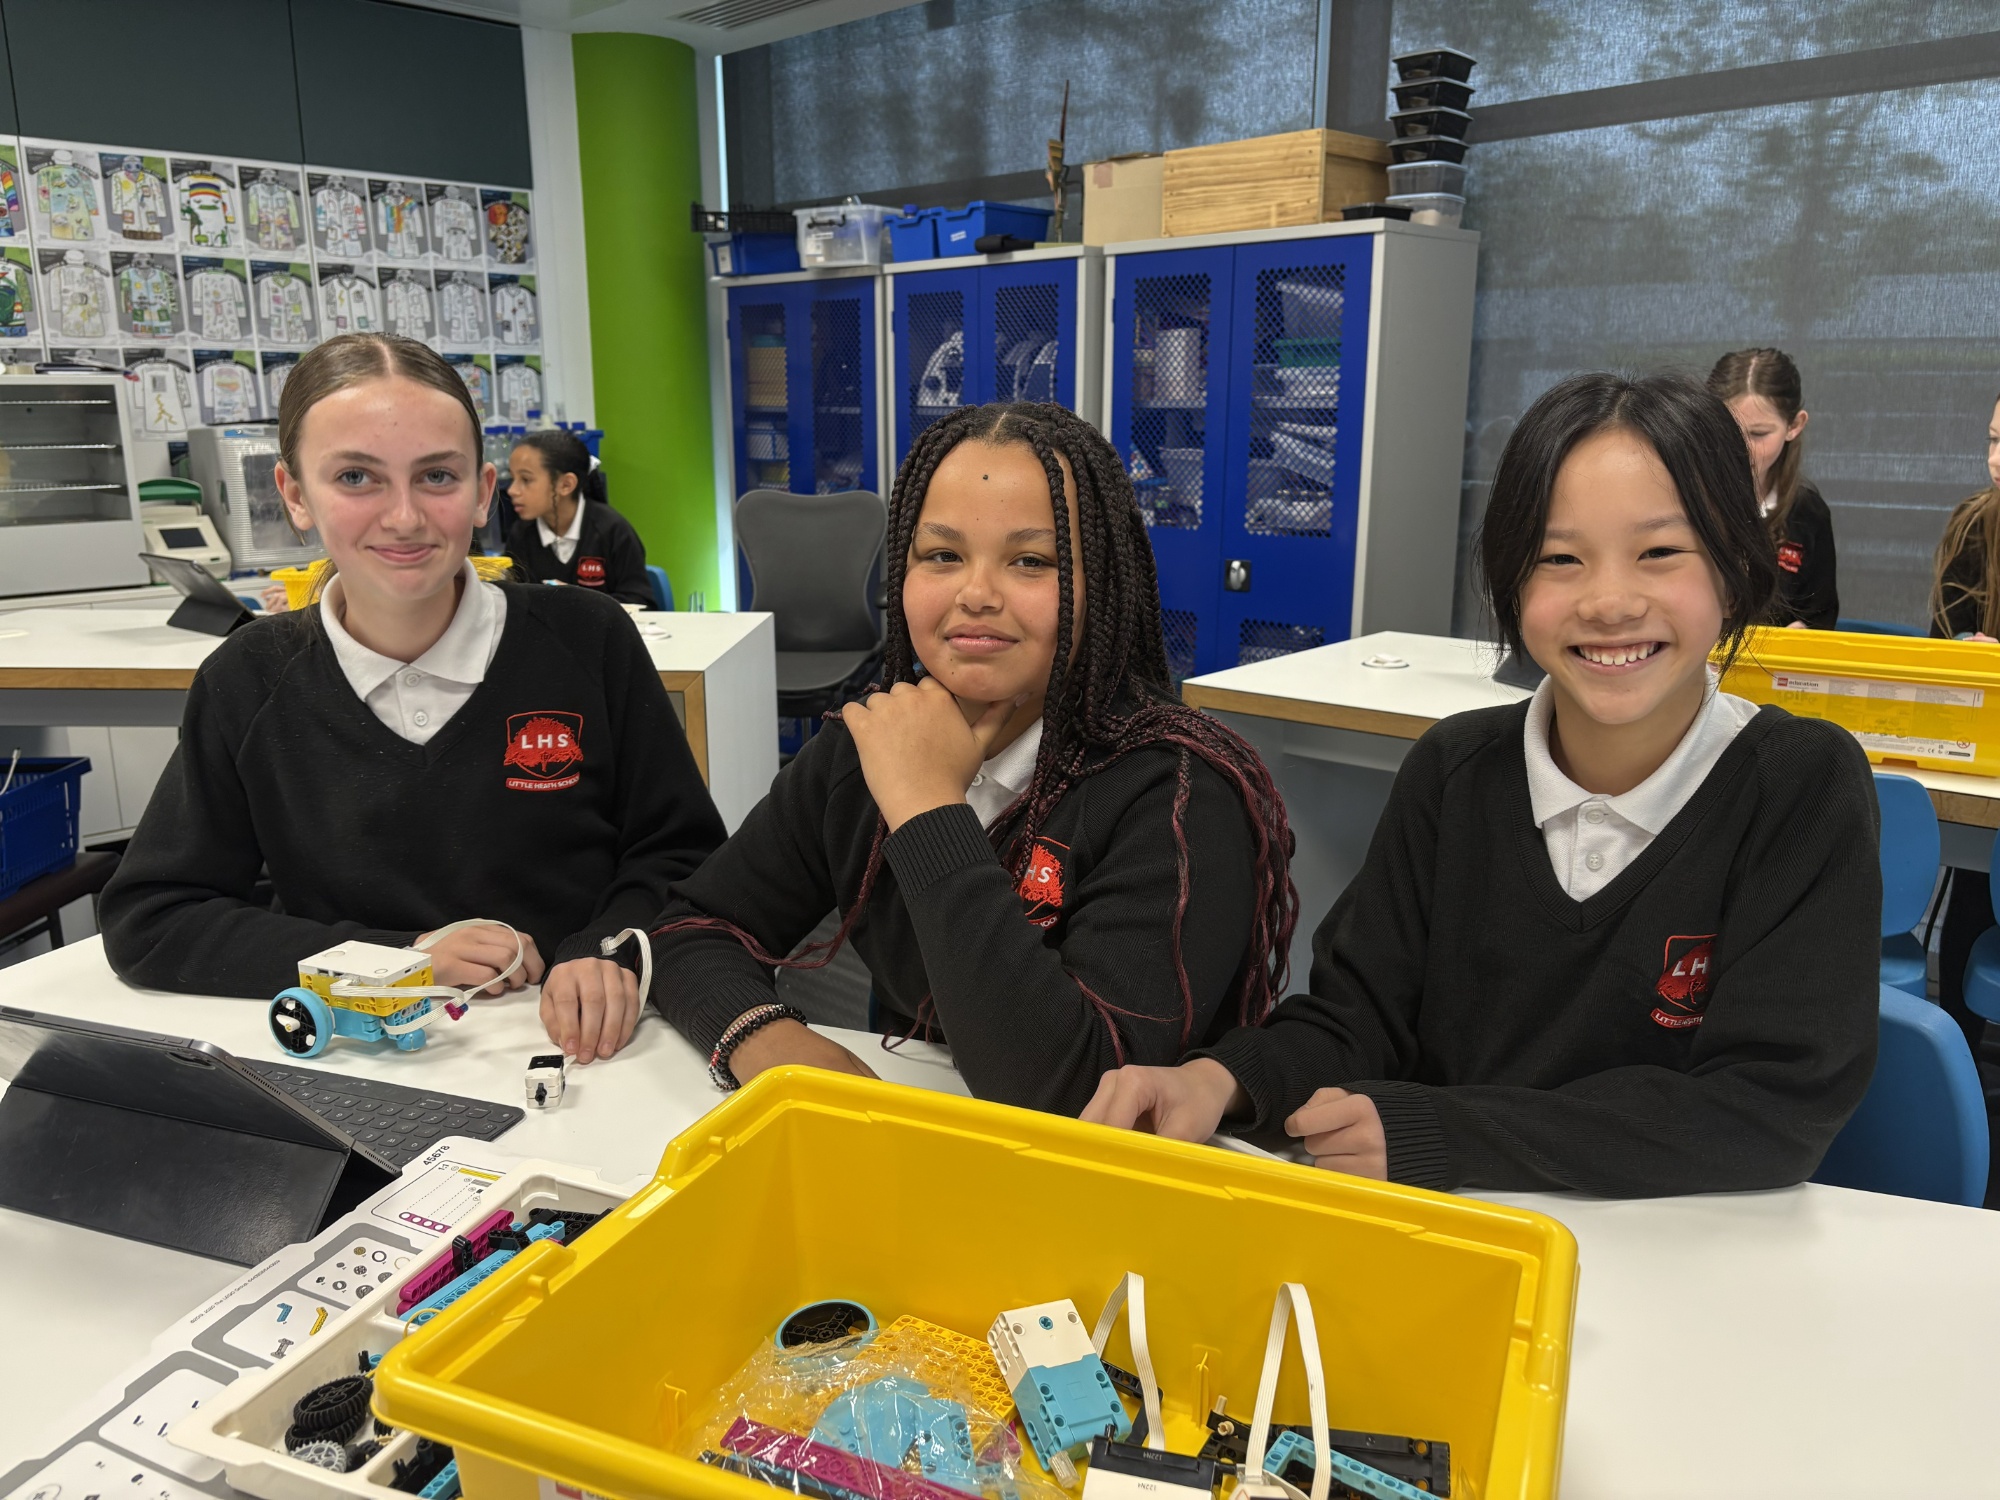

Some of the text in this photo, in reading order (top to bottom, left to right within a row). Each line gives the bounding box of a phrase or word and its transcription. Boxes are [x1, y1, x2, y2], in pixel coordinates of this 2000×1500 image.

[582, 564, 601, 572] LHS
[521, 733, 569, 749] LHS
[508, 780, 533, 788] LITTLE
[1024, 865, 1052, 883] HS
[1671, 956, 1709, 977] LH
[1655, 1012, 1682, 1026] LITTLE
[423, 1145, 451, 1166] 45678
[1143, 1451, 1162, 1460] 122N4
[1137, 1482, 1157, 1491] 122N4
